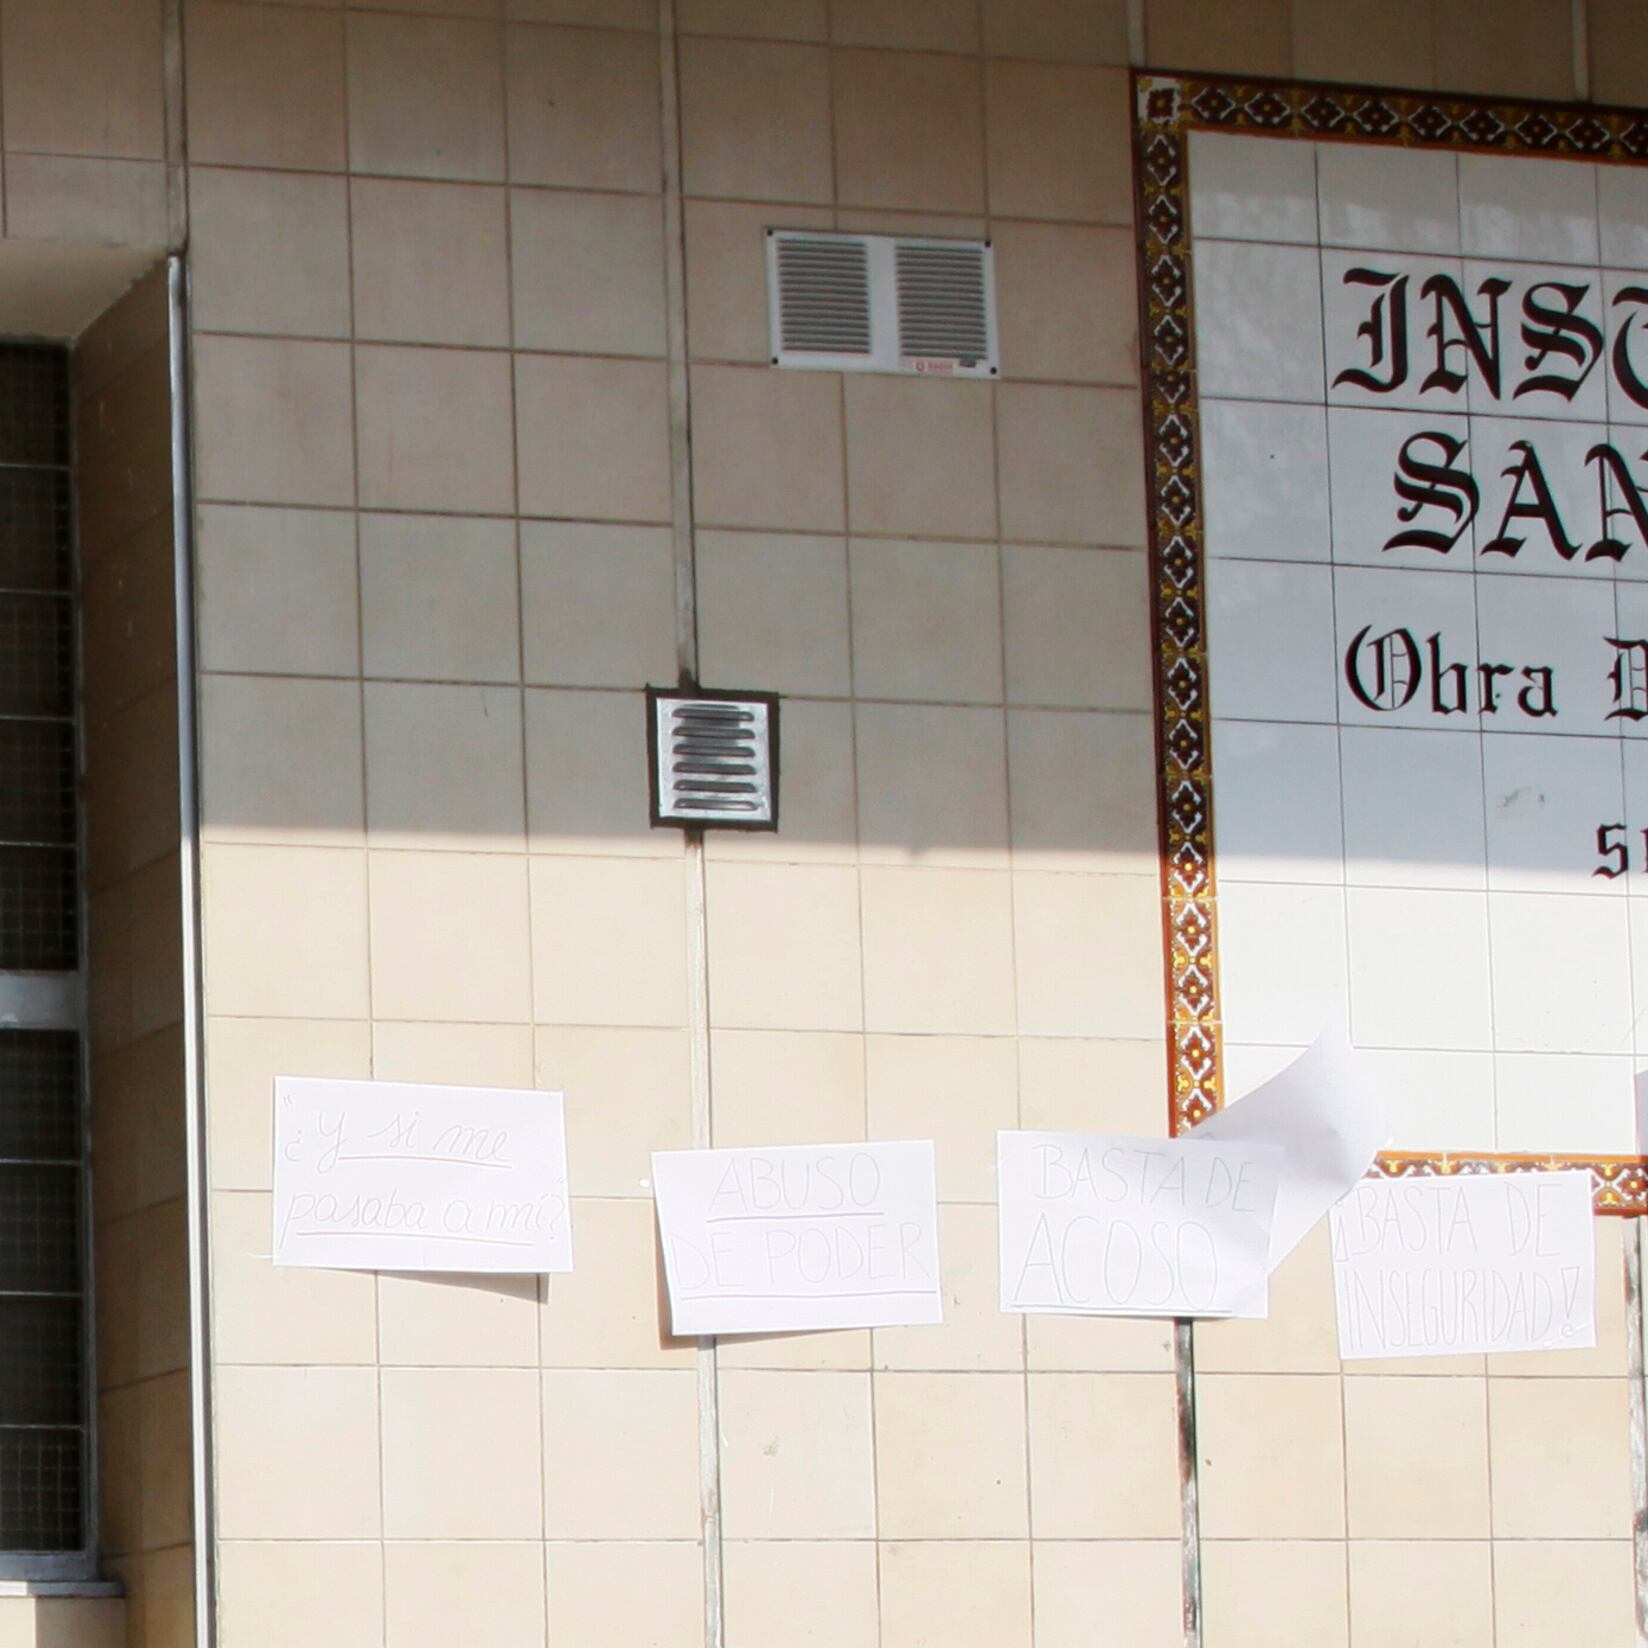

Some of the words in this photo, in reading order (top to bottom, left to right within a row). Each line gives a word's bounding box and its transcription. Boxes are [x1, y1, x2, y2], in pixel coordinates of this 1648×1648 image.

[1344, 623, 1559, 719] Obra
[432, 1122, 511, 1161] me
[707, 1153, 882, 1213] ABUSO
[1032, 1144, 1187, 1207] BASTA
[1204, 1157, 1257, 1213] DE
[278, 1187, 428, 1250] pasaba
[442, 1198, 476, 1233] a
[1504, 1181, 1564, 1258] DE
[668, 1230, 745, 1290] DE
[764, 1221, 934, 1284] PODER
[1013, 1211, 1220, 1312] ACOSO
